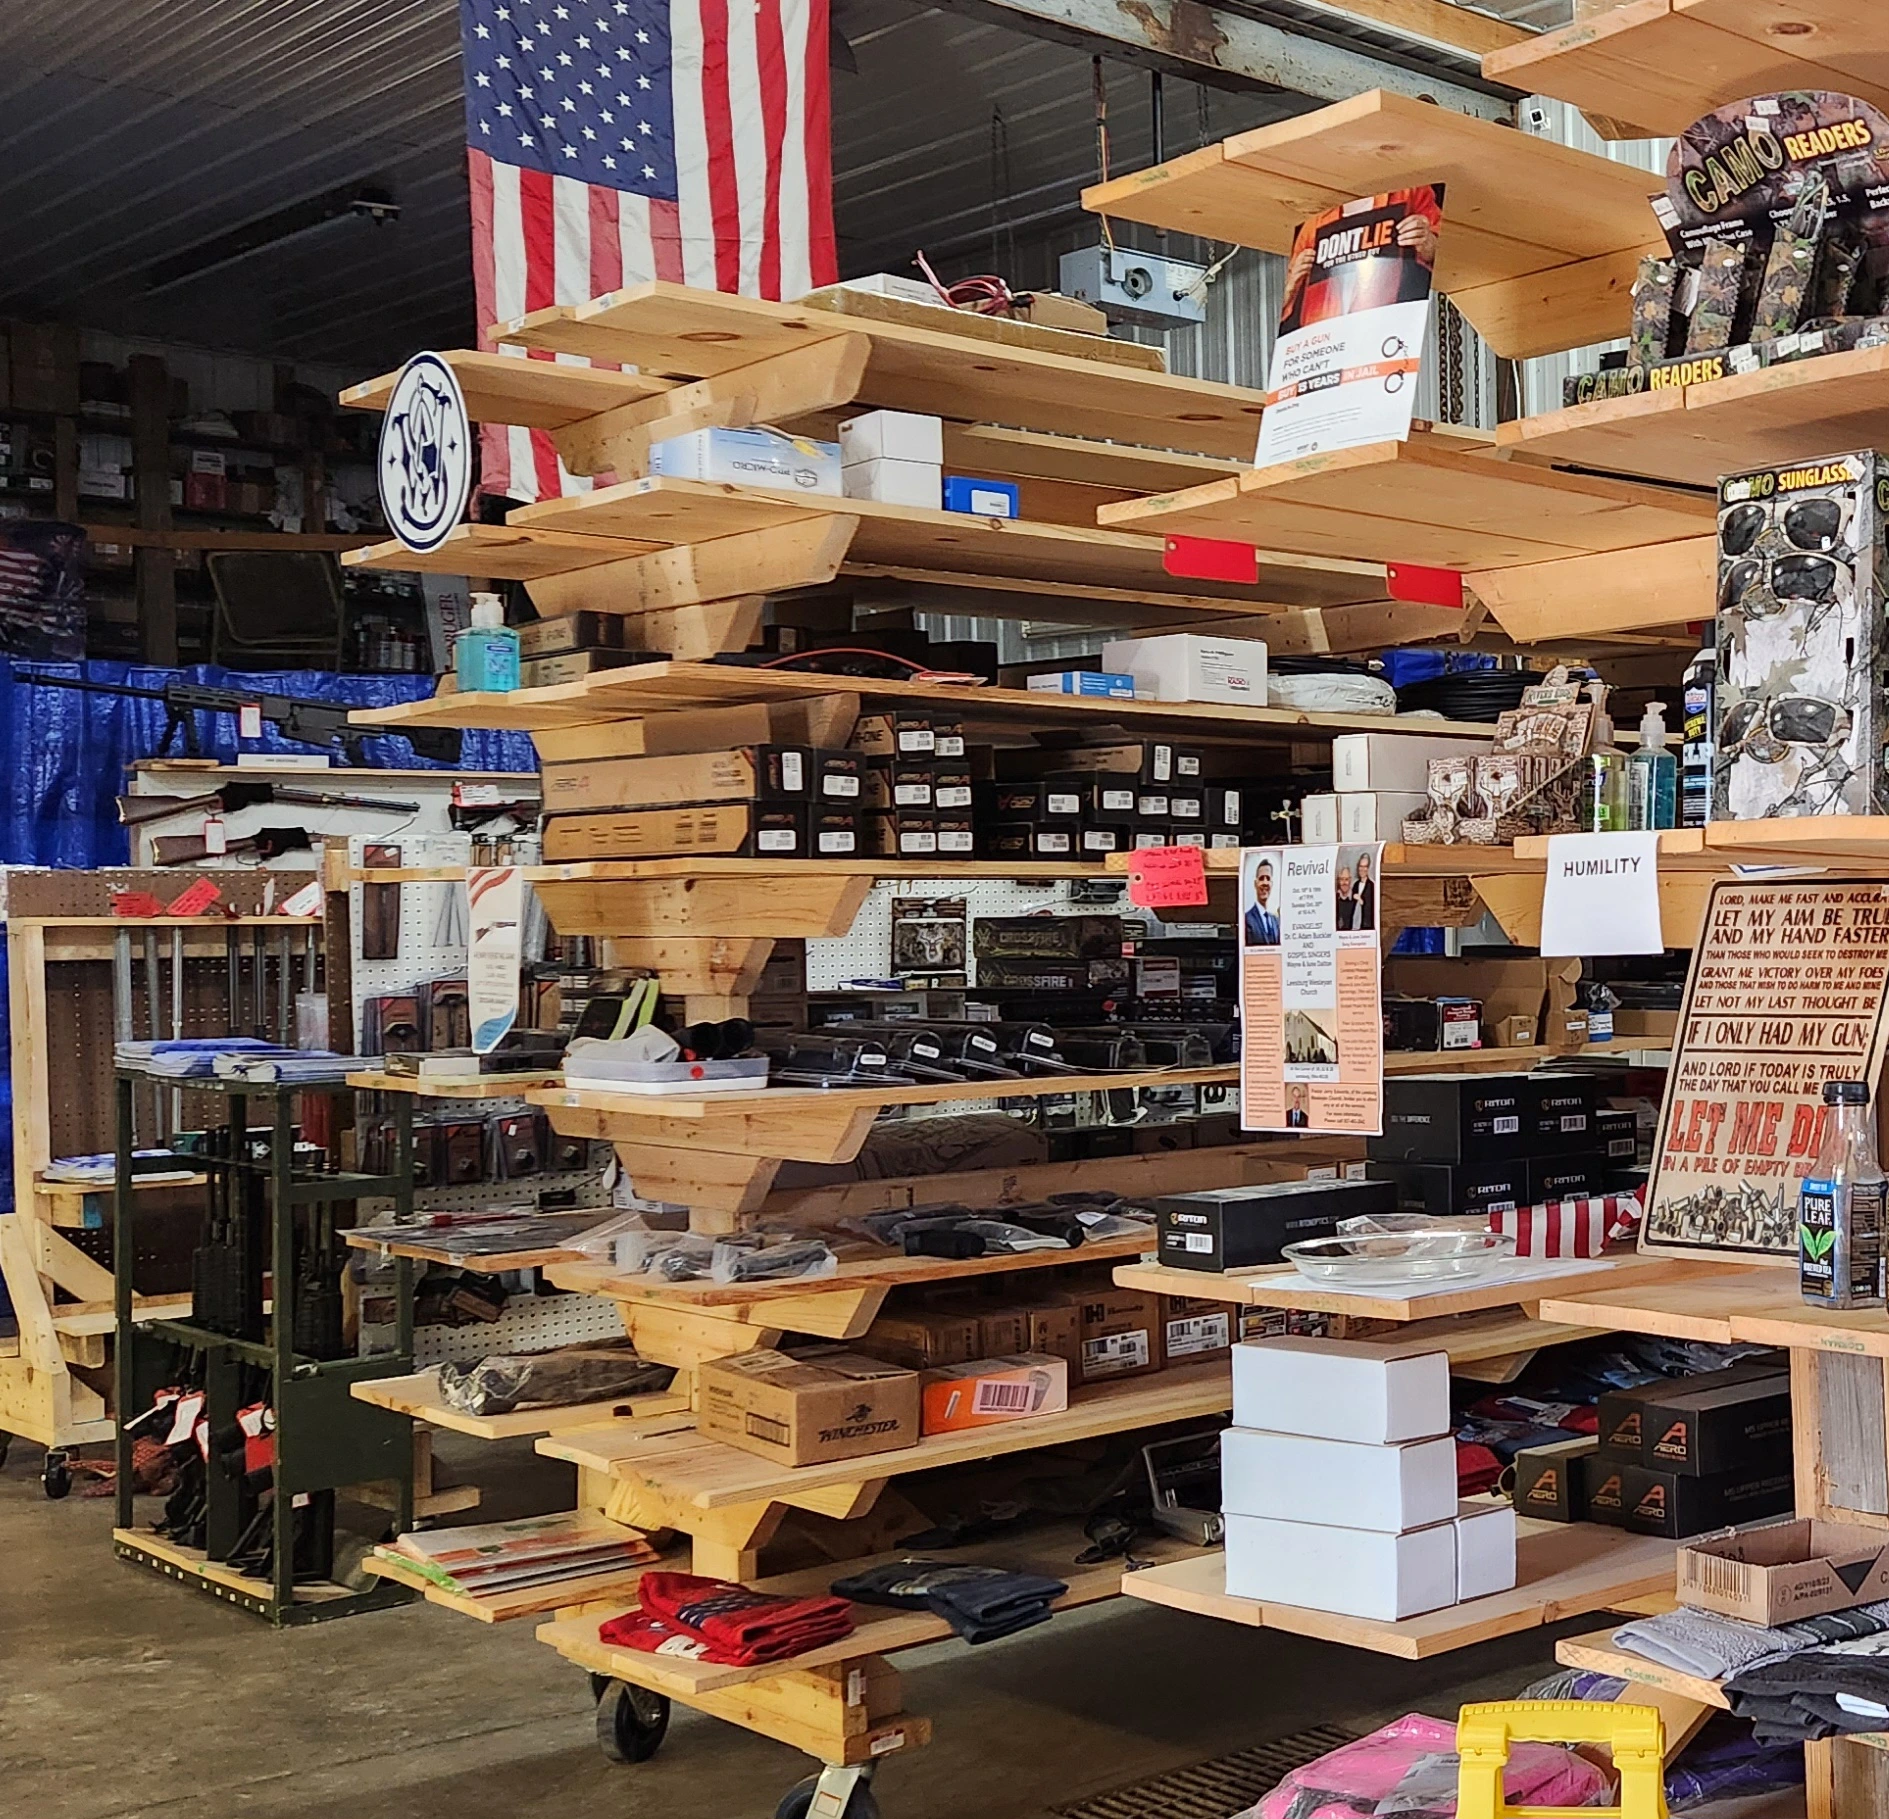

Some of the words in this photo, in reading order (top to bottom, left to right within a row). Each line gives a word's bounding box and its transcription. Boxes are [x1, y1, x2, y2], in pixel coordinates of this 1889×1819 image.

[1685, 129, 1784, 213] CAMO
[1783, 119, 1872, 161] READERS
[1311, 332, 1331, 346] GUN
[1284, 355, 1300, 369] FOR
[1301, 342, 1345, 364] SOMEONE
[1282, 367, 1300, 383] WHO
[1302, 359, 1330, 376] CAN'T
[1277, 386, 1296, 401] BUY
[1308, 372, 1340, 392] YEARS
[1357, 365, 1379, 380] JAIL
[1577, 364, 1645, 405] CAMO
[1650, 357, 1723, 392] READERS
[1288, 859, 1329, 876] Revival
[1564, 856, 1641, 877] HUMILITY
[1720, 894, 1745, 907] LORD,
[1749, 893, 1775, 904] MAKE
[1778, 893, 1792, 904] ME
[1796, 892, 1819, 904] FAST
[1822, 892, 1844, 903] AND
[1714, 909, 1742, 927] LET
[1749, 909, 1775, 927] MY
[1781, 908, 1814, 926] AIM
[1822, 908, 1844, 926] BE
[1000, 931, 1060, 945] CROSSFIRE
[1709, 928, 1743, 944] AND
[1750, 928, 1775, 944] MY
[1780, 927, 1826, 944] HAND
[1706, 950, 1726, 960] THAN
[1727, 950, 1750, 960] THOSE
[1752, 950, 1771, 960] WHO
[1772, 950, 1799, 960] WOULD
[1801, 950, 1825, 960] SEEK
[1826, 950, 1836, 959] TO
[1838, 949, 1874, 959] DESTROY
[1875, 949, 1888, 959] ME
[1701, 967, 1734, 979] GRANT
[1737, 967, 1753, 979] ME
[1758, 967, 1801, 979] VICTORY
[1804, 967, 1833, 979] OVER
[1837, 967, 1855, 979] MY
[1858, 967, 1884, 979] FOES
[1003, 975, 1067, 988] CROSSFIRE
[1698, 981, 1713, 990] AND
[1714, 981, 1737, 990] THOSE
[1738, 981, 1757, 990] THAT
[1758, 981, 1776, 990] WISH
[1777, 981, 1786, 990] TO
[1787, 981, 1798, 990] DO
[1800, 981, 1820, 991] HARM
[1822, 981, 1832, 991] TO
[1833, 981, 1846, 991] ME
[1847, 981, 1862, 991] AND
[1863, 981, 1882, 991] MINE
[1694, 996, 1712, 1009] LET
[1715, 996, 1742, 1009] NOT
[1747, 996, 1764, 1009] MY
[1768, 996, 1796, 1009] LAST
[1801, 996, 1857, 1009] THOUGHT
[1862, 996, 1878, 1009] BE
[1687, 1021, 1702, 1044] IF
[1715, 1022, 1754, 1046] ONLY
[1759, 1022, 1795, 1046] HAD
[1800, 1023, 1827, 1047] MY
[1831, 1022, 1870, 1049] GUN;
[1682, 1061, 1707, 1076] AND
[1708, 1061, 1742, 1077] LORD
[1744, 1062, 1756, 1078] IF
[1758, 1063, 1800, 1079] TODAY
[1802, 1064, 1816, 1078] IS
[1818, 1064, 1862, 1080] TRULY
[1678, 1078, 1698, 1092] THE
[1699, 1079, 1721, 1092] DAY
[1721, 1079, 1748, 1093] THAT
[1749, 1080, 1772, 1094] YOU
[1772, 1081, 1801, 1095] CALL
[1801, 1082, 1819, 1096] ME
[1484, 1098, 1515, 1108] RITON
[1551, 1098, 1582, 1107] RITON
[1602, 1122, 1632, 1131] RITON
[1666, 1100, 1725, 1153] LET
[1728, 1102, 1784, 1157] ME
[1662, 1155, 1677, 1172] IN
[1679, 1156, 1689, 1172] A
[1693, 1157, 1717, 1174] PILE
[1722, 1158, 1741, 1175] OF
[1742, 1158, 1788, 1177] EMPTY
[1554, 1174, 1586, 1185] RITON
[1477, 1183, 1511, 1195] RITON
[1804, 1197, 1832, 1212] PURE
[1178, 1214, 1207, 1225] RITON
[818, 1419, 901, 1444] WINCHESTER
[1608, 1433, 1641, 1444] AERO
[1653, 1443, 1687, 1455] AERO
[1527, 1489, 1557, 1501] AERO
[1591, 1495, 1621, 1507] AERO
[1633, 1506, 1665, 1518] AERO
